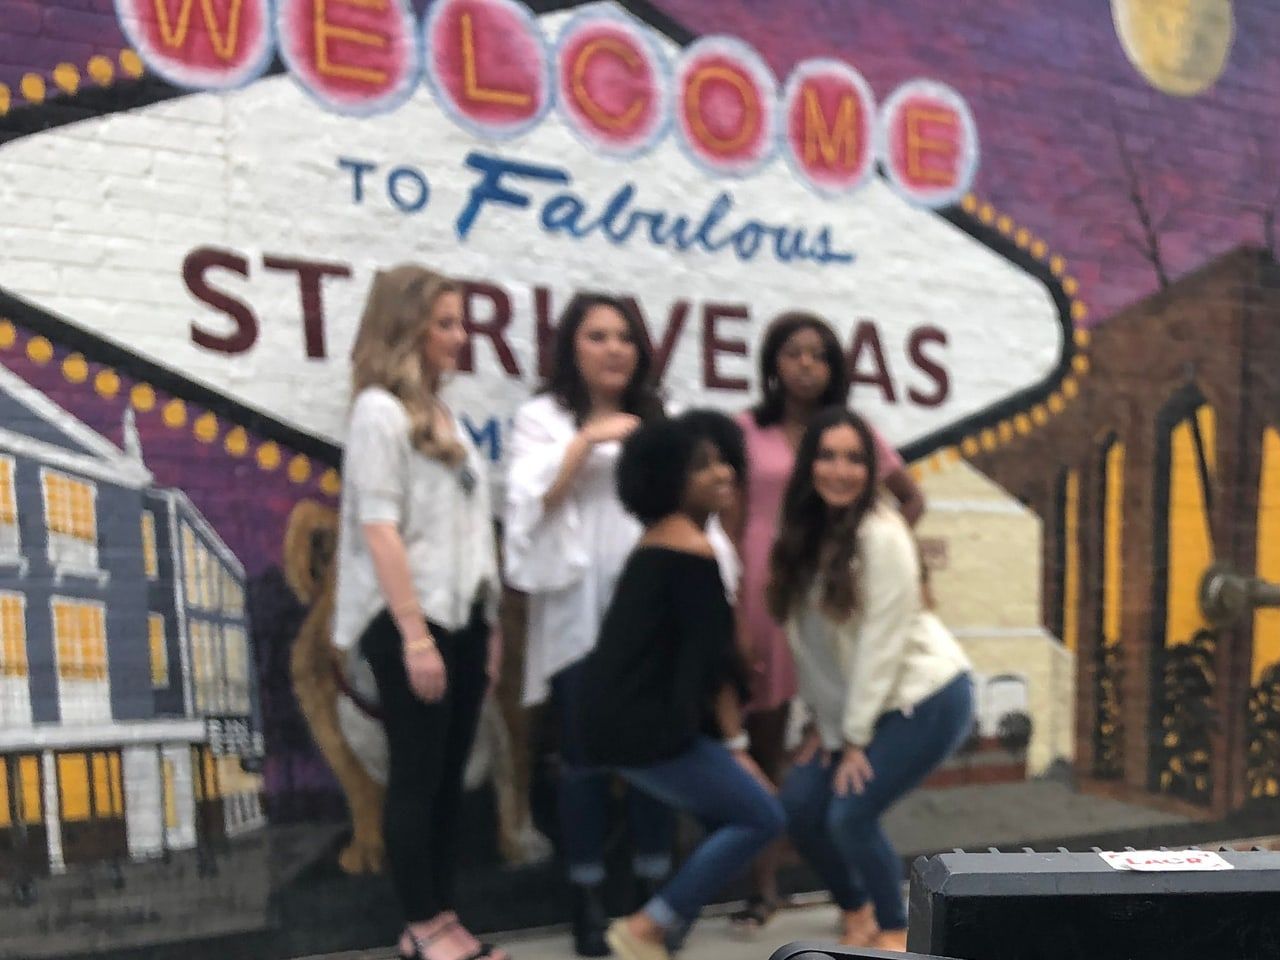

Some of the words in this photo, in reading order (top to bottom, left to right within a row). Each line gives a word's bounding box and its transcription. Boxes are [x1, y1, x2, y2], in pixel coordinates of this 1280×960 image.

[153, 0, 956, 188] WELCOME
[337, 157, 431, 212] TO
[456, 151, 856, 264] Fabulous
[181, 246, 950, 408] STRVEAS
